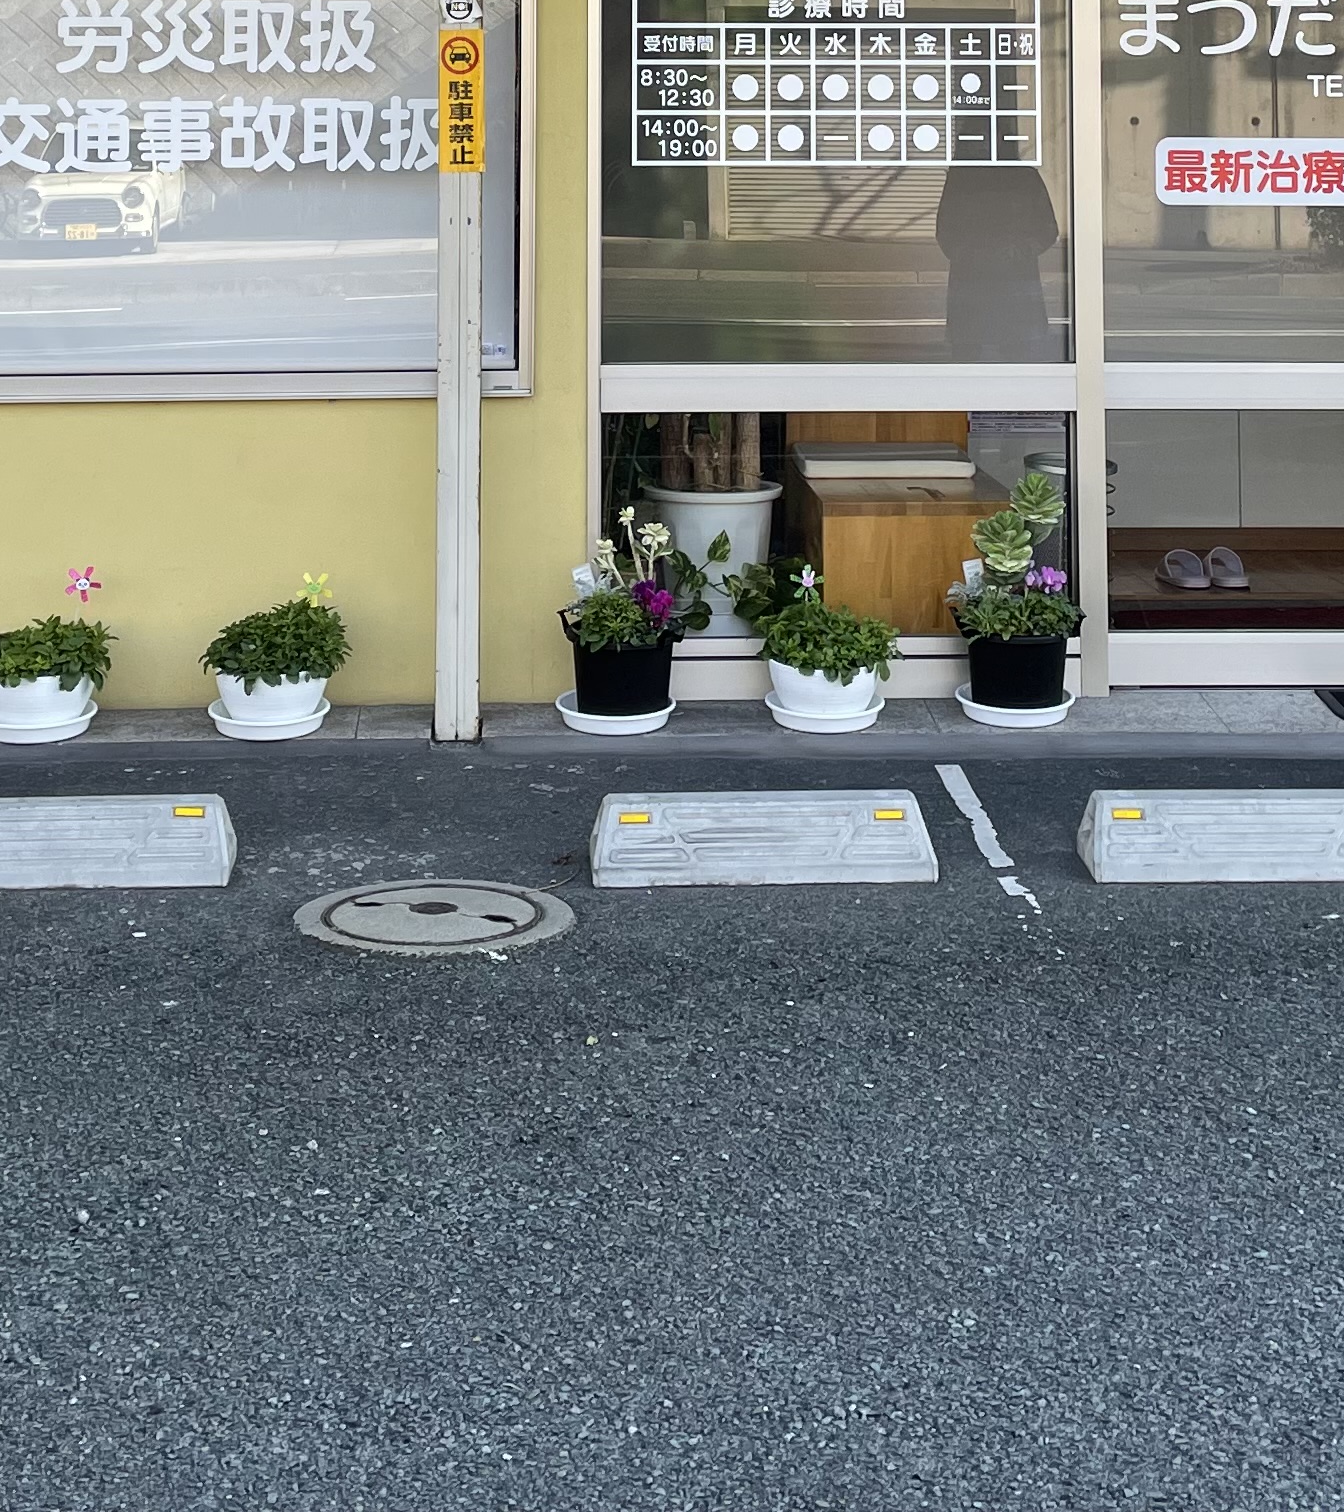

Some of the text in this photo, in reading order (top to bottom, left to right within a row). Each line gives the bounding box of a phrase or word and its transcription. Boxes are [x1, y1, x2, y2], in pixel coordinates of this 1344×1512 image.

[643, 32, 1034, 56] 受付時間 月 火 水 木 金 土 日・祝
[658, 88, 715, 107] 12:30
[447, 80, 475, 165] 駐車禁止
[658, 138, 718, 157] 19:00
